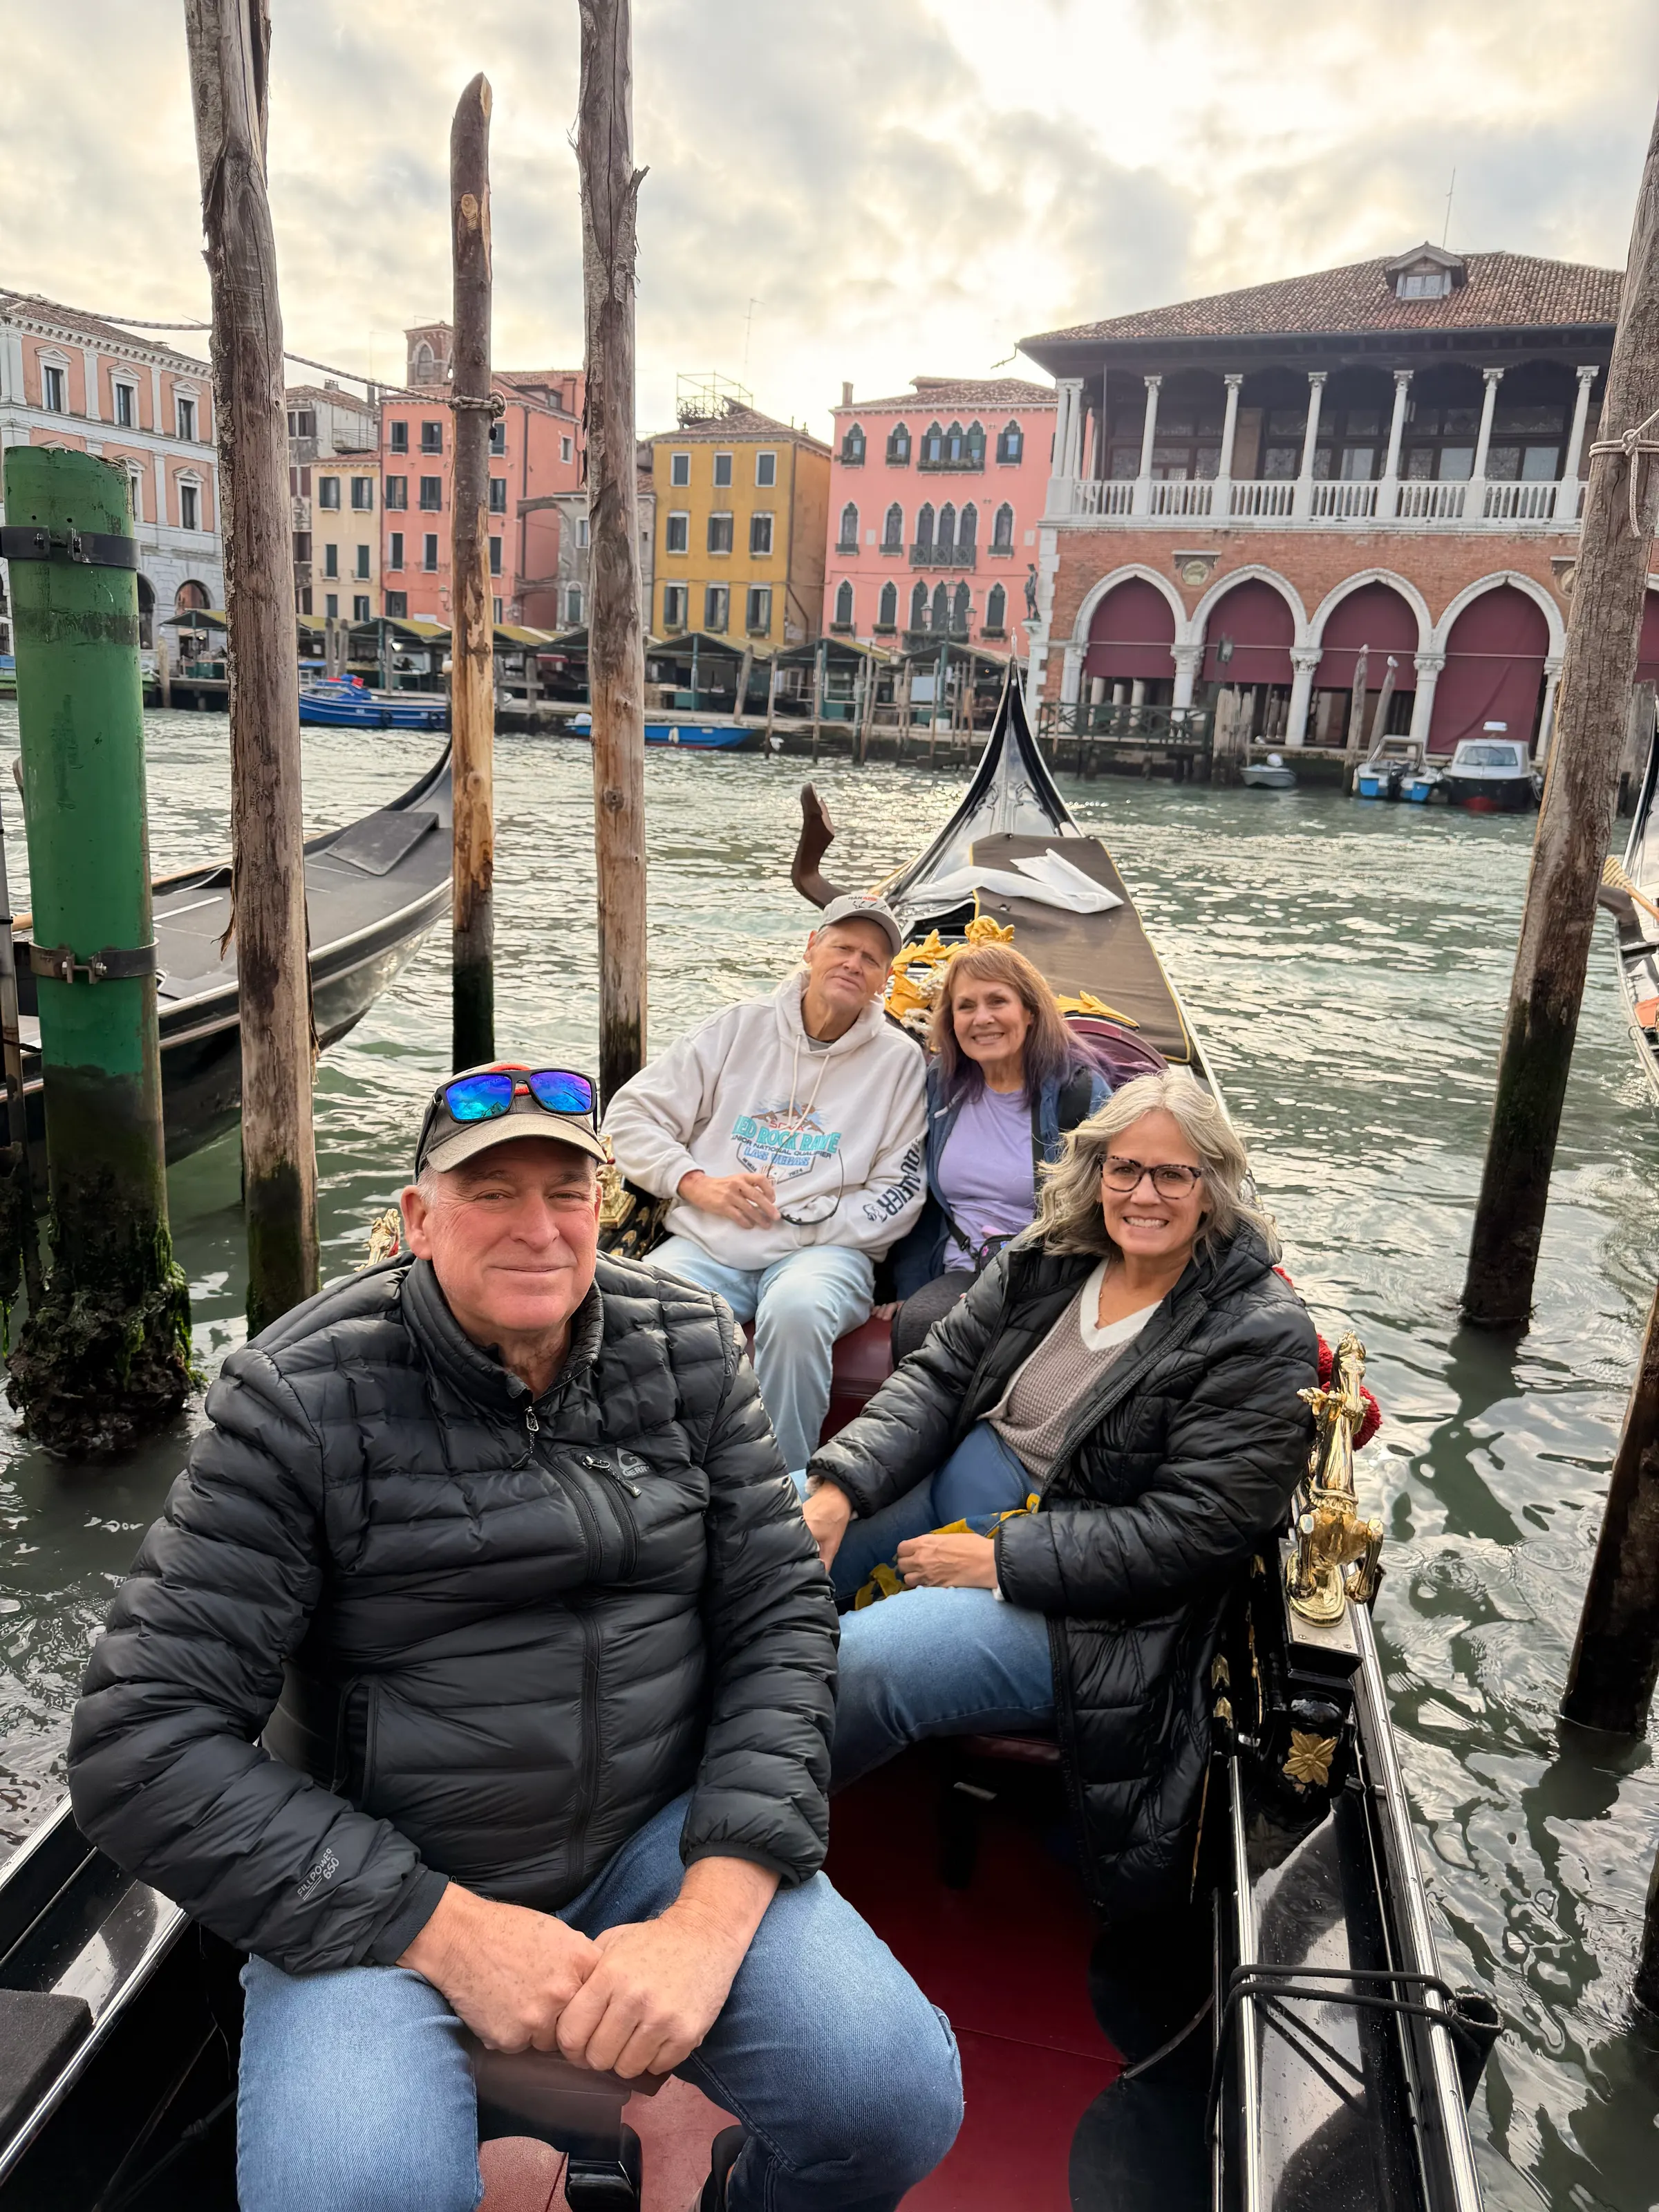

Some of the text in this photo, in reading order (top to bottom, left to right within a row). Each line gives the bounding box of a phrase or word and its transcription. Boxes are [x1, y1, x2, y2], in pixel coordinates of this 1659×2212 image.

[756, 1126, 800, 1150] ROCK
[800, 1132, 841, 1154] RAVE
[744, 1147, 769, 1161] LAS
[753, 1143, 791, 1155] NATIONAL
[622, 1465, 650, 1477] GERR
[323, 1857, 339, 1880] 650
